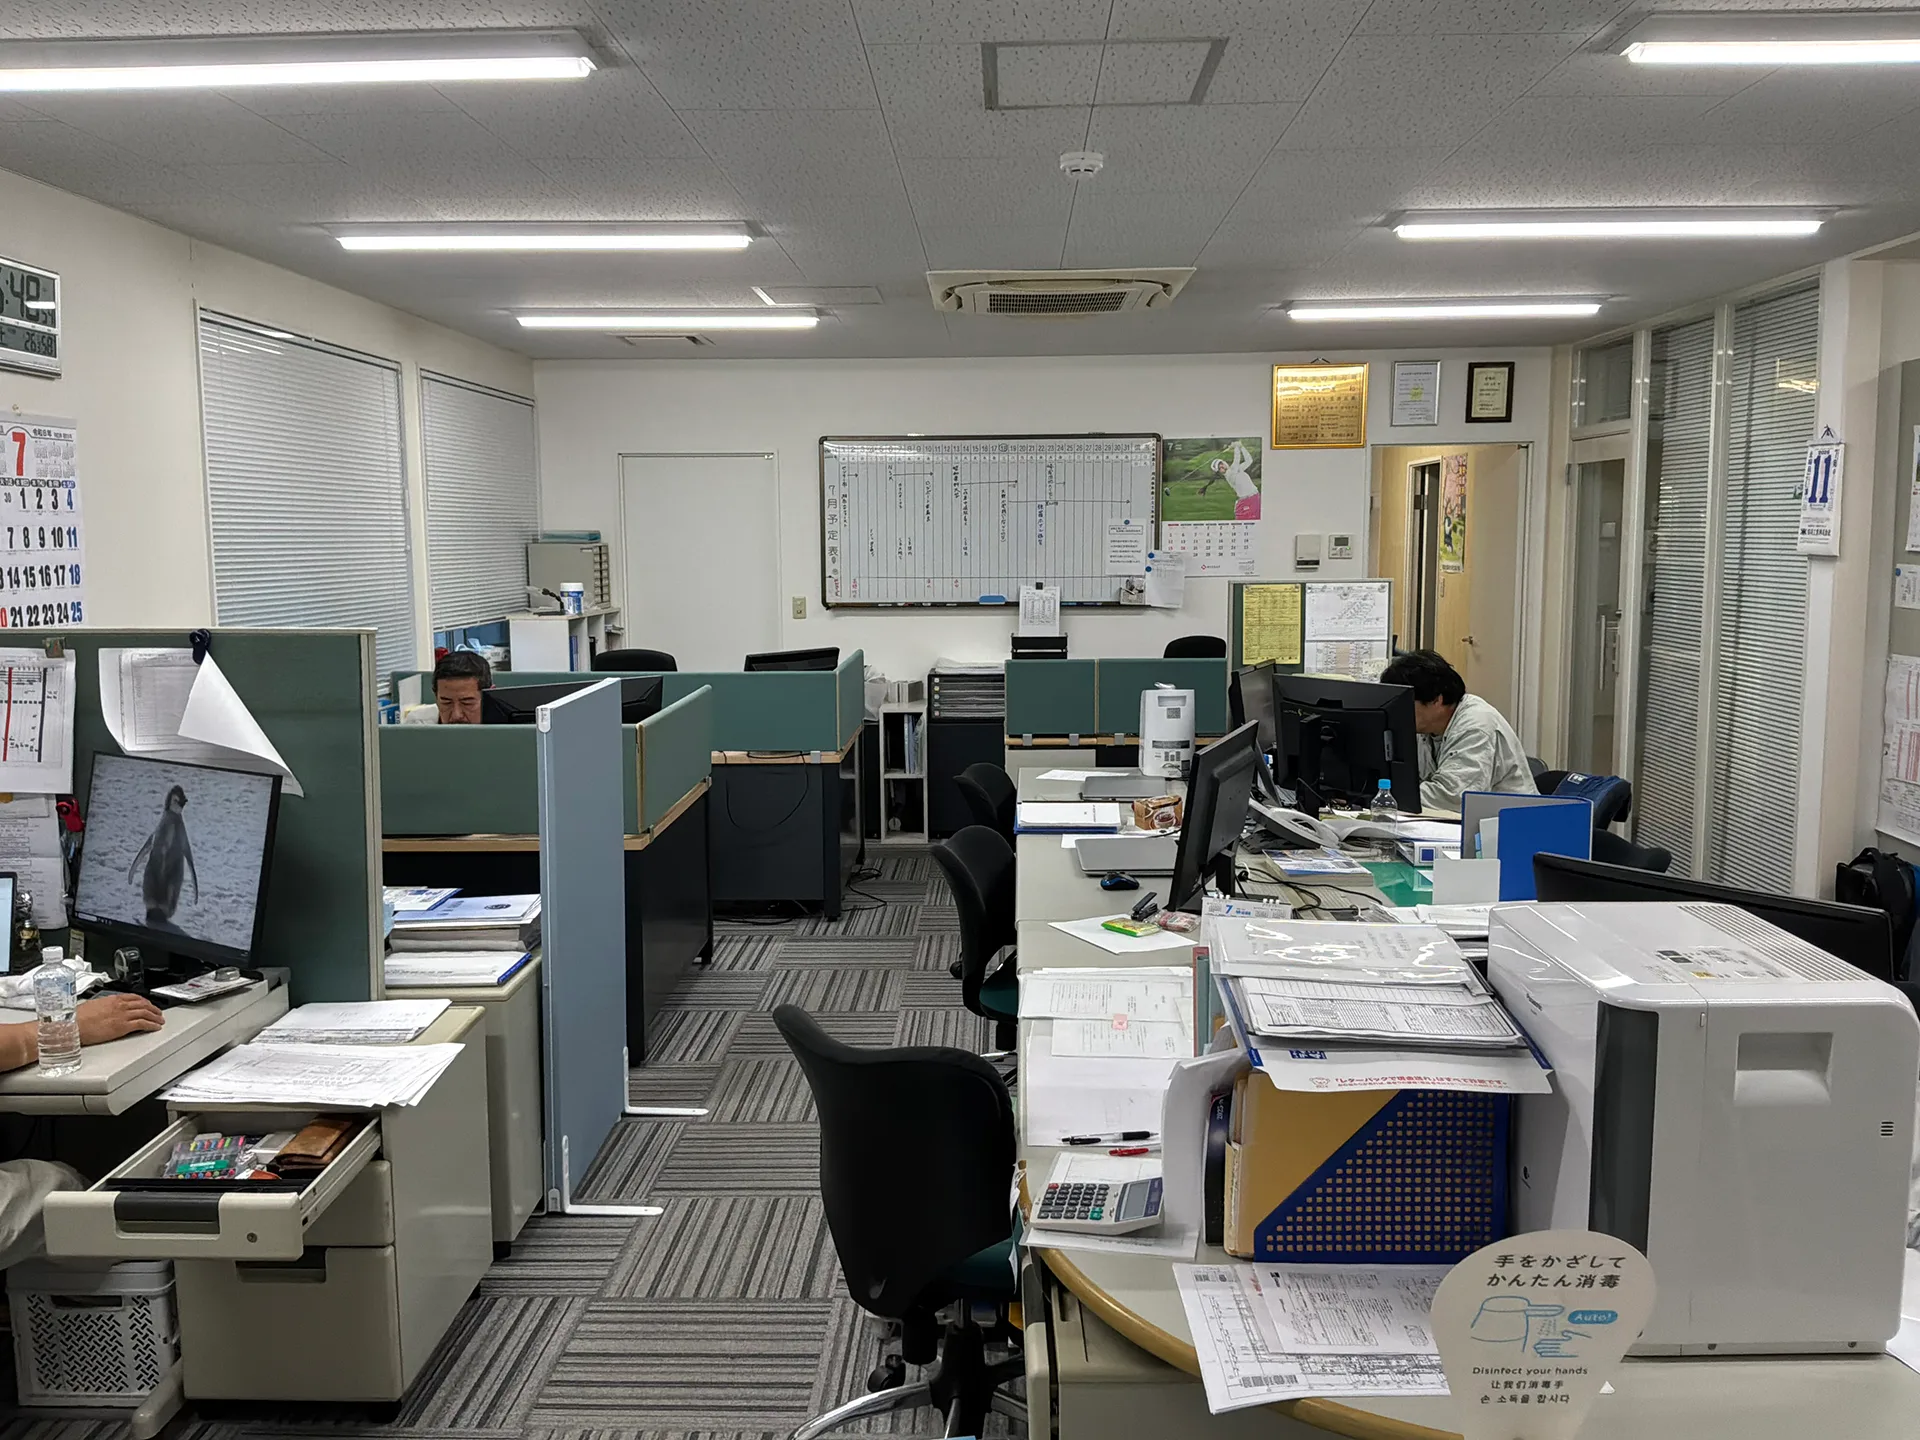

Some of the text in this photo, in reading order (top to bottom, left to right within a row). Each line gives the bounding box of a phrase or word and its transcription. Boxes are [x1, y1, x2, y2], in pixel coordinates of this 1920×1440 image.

[12, 431, 26, 476] 7
[1808, 455, 1831, 503] 11
[20, 487, 26, 509] 1
[36, 488, 43, 509] 2
[51, 488, 59, 510] 3
[67, 489, 73, 510] 4
[7, 526, 78, 549] 7 8 9 10 11
[7, 566, 20, 589] 14
[23, 565, 36, 588] 15
[39, 564, 52, 587] 16
[54, 564, 65, 586] 17
[69, 564, 81, 585] 18
[0, 601, 83, 628] 0 21 22 23 24 25
[1225, 904, 1234, 914] 7
[1494, 1254, 1627, 1270] 手をかざして
[1486, 1273, 1621, 1289] かんたん消毒
[1574, 1312, 1613, 1322] Auto!
[1472, 1366, 1588, 1377] Disinfect your hands
